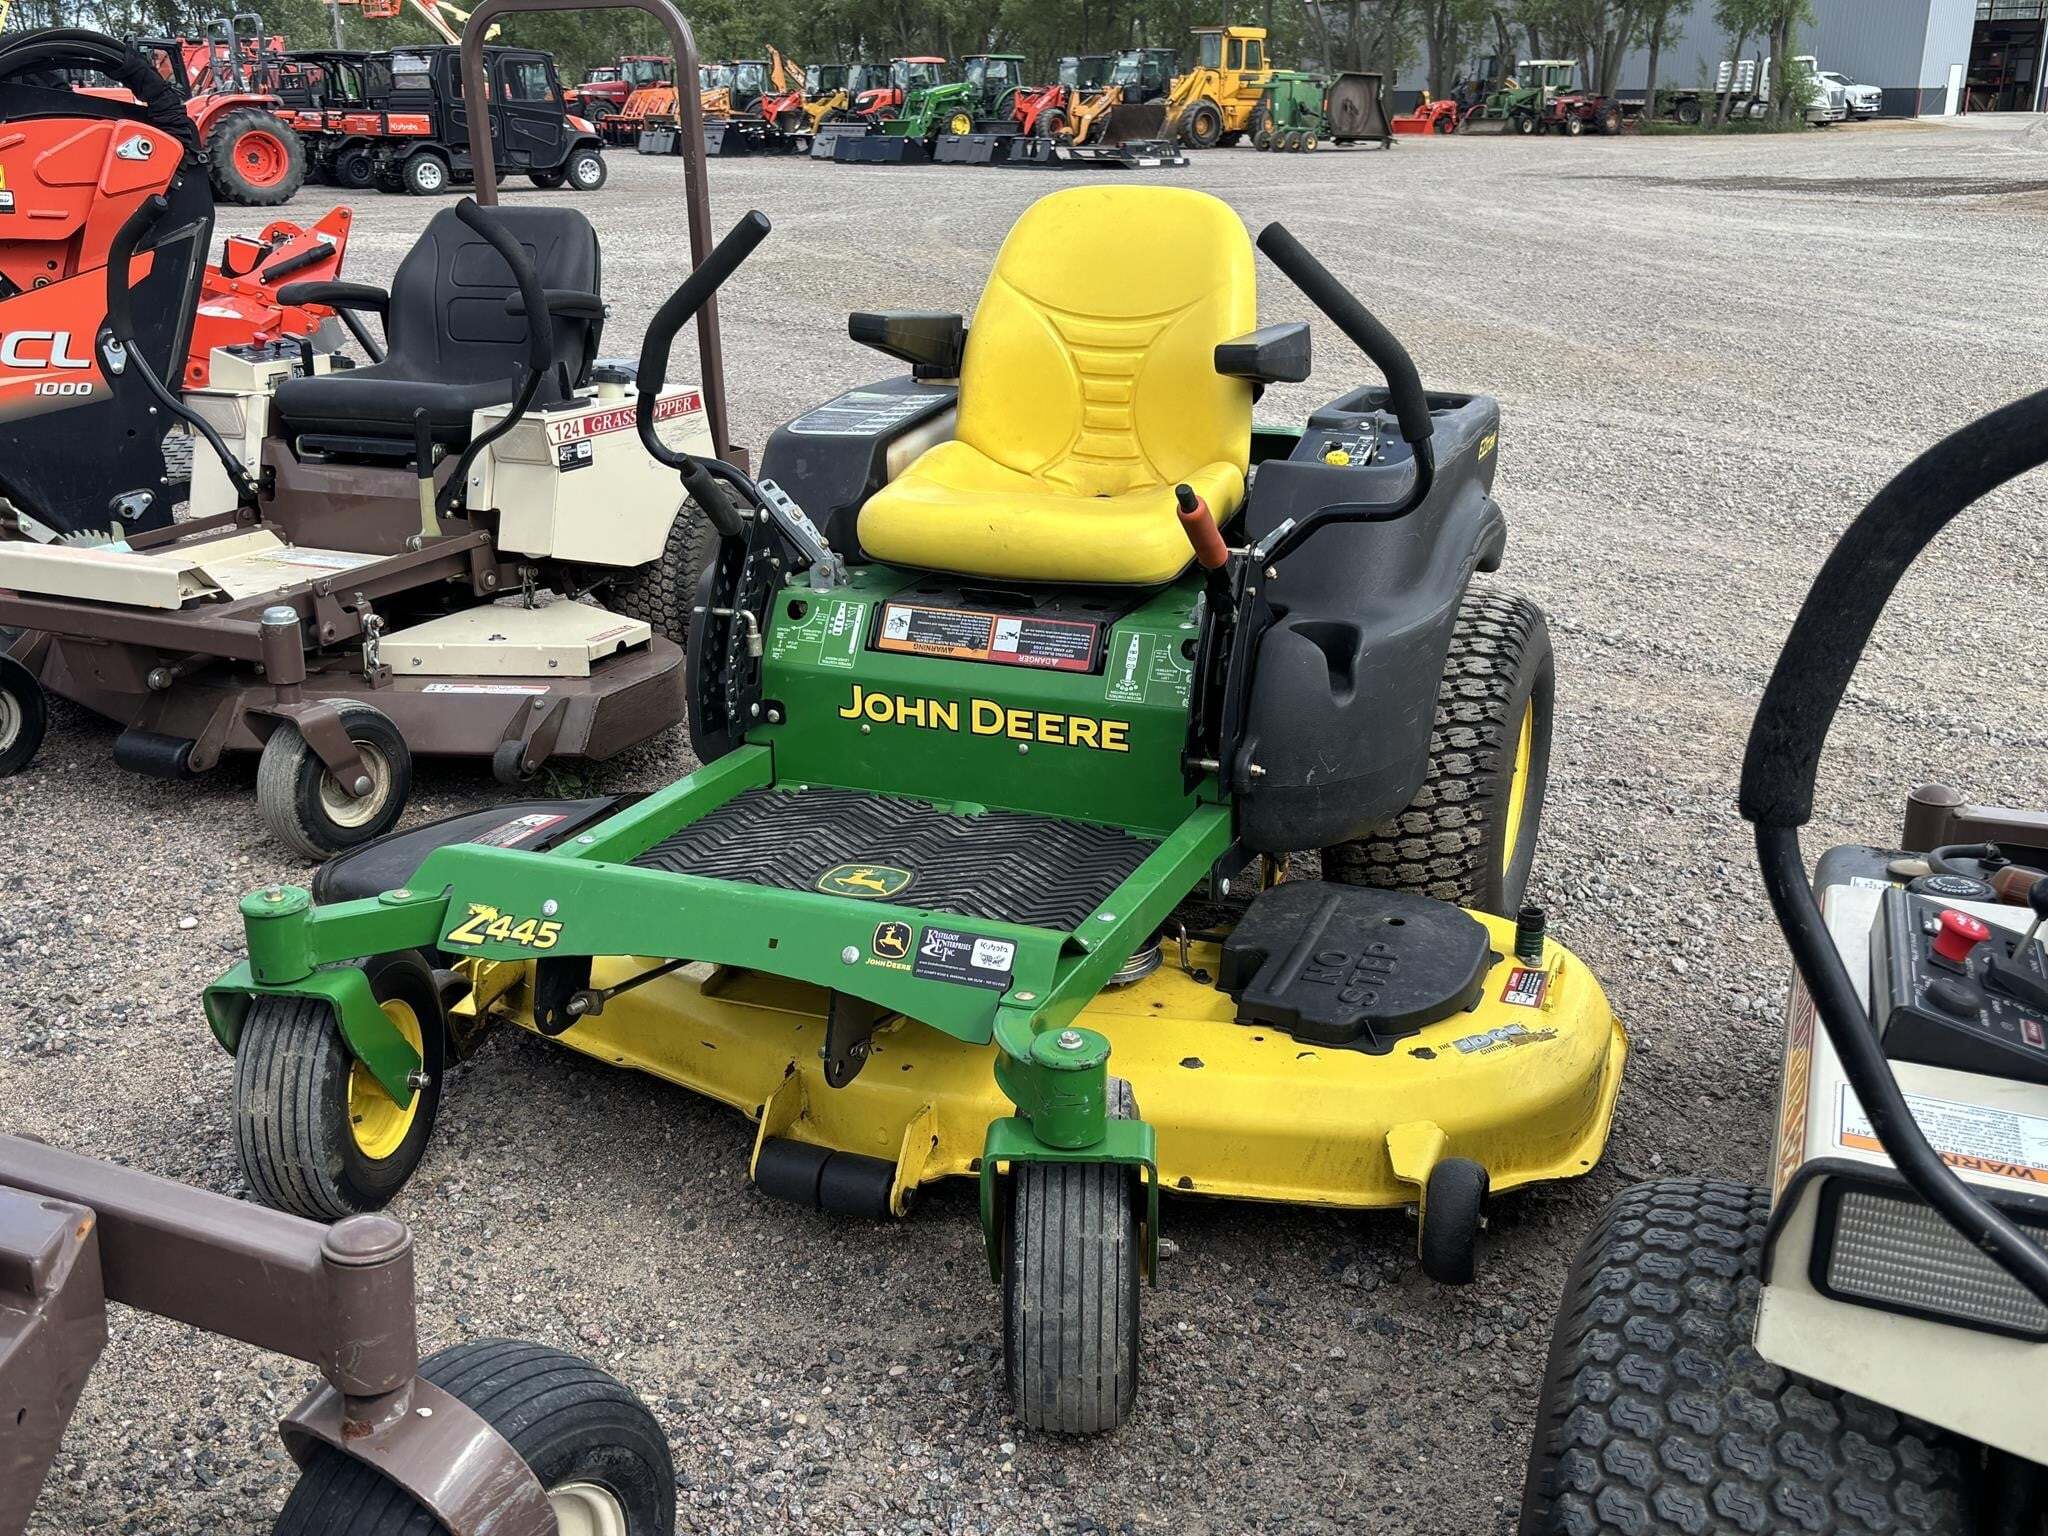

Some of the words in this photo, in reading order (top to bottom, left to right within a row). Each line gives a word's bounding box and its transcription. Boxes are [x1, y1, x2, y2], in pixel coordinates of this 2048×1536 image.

[34, 382, 93, 396] 1000
[554, 421, 580, 441] 124
[591, 398, 692, 432] GRASSPPER
[913, 643, 949, 653] WARNING
[1018, 654, 1051, 665] DANGER
[839, 684, 959, 731] JOHN
[970, 698, 1130, 752] DEERE
[446, 902, 563, 949] Z445
[980, 941, 1009, 953] Kubota
[865, 958, 886, 967] JOHN
[886, 961, 912, 971] DEERE
[1301, 951, 1352, 986] NO
[1338, 942, 1399, 1006] STEP
[1940, 1153, 2036, 1180] WARN
